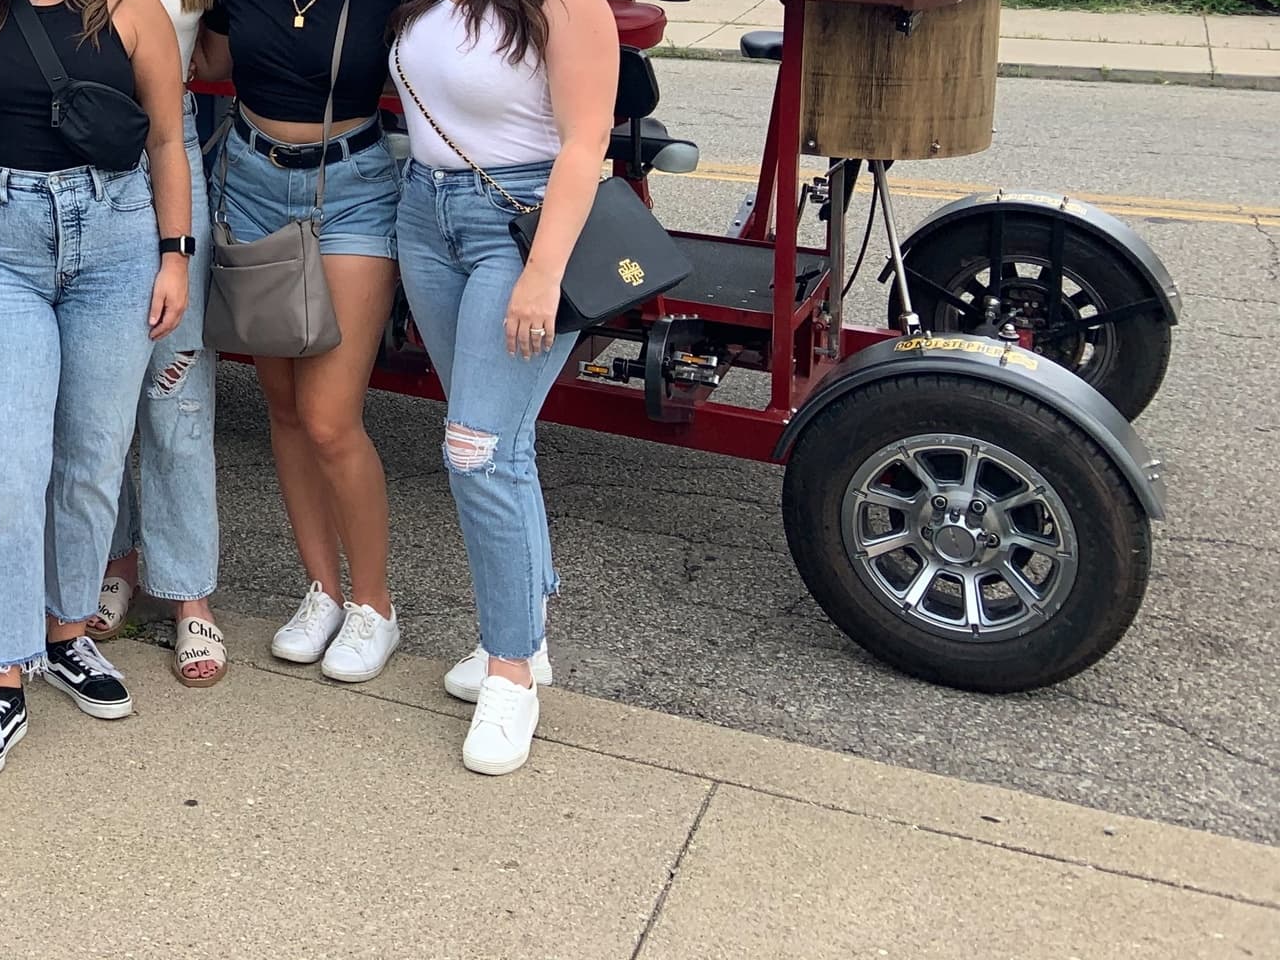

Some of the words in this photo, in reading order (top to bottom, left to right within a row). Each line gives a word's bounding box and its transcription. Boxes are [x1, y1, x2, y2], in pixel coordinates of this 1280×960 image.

[942, 341, 974, 351] STEP
[976, 343, 1003, 356] HER
[179, 646, 211, 663] Chloé
